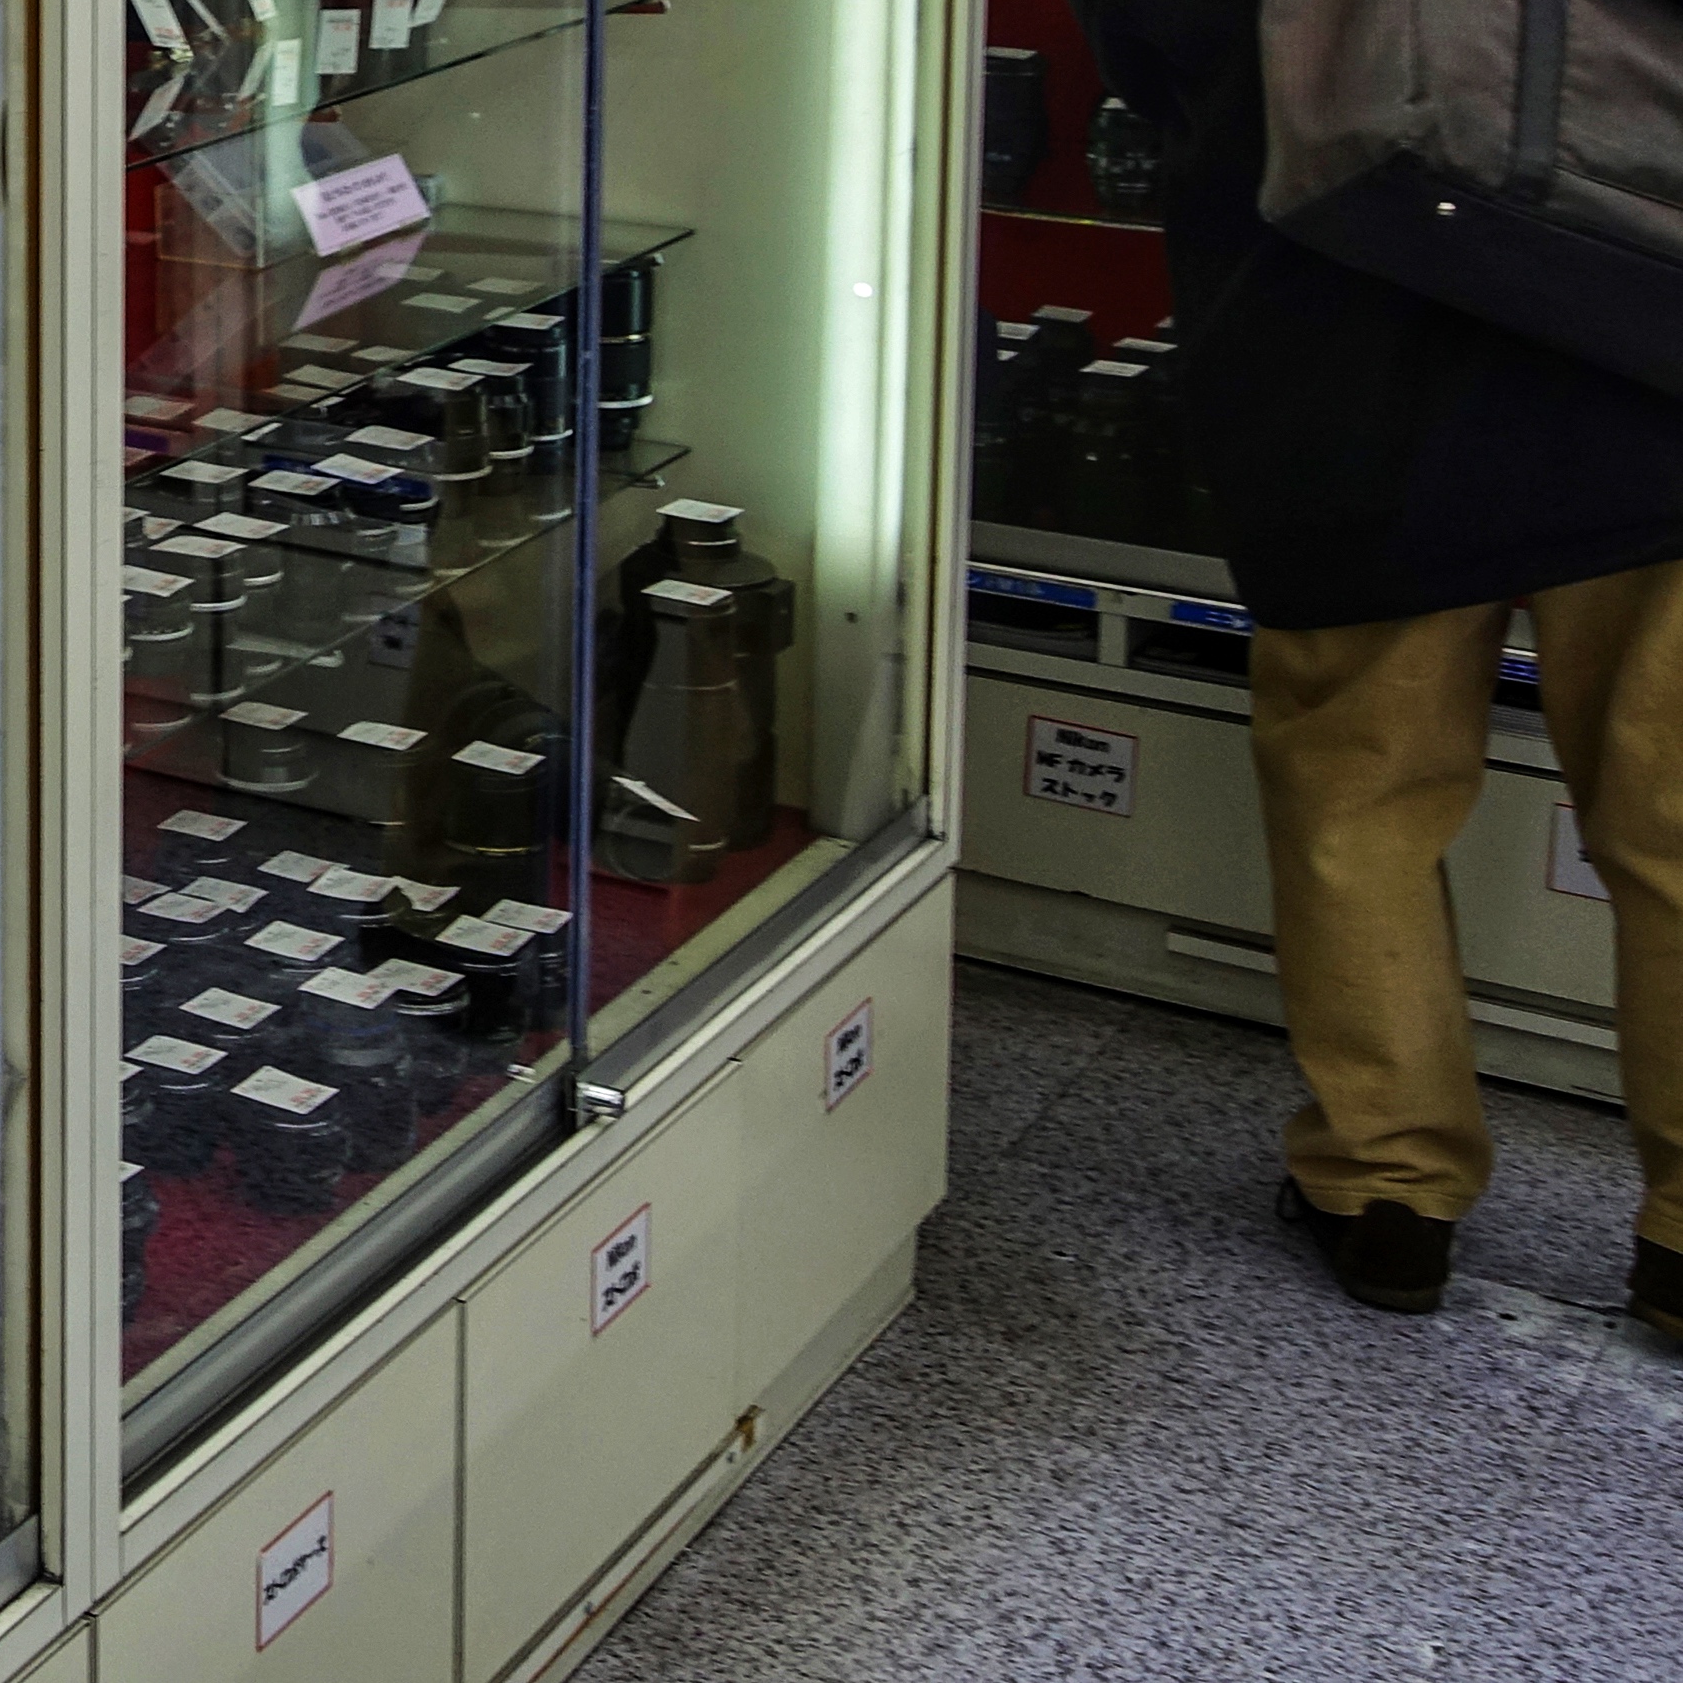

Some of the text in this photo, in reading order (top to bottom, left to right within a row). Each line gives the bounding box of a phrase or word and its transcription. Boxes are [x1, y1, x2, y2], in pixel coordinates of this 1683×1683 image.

[1066, 752, 1127, 784] カメラ
[1040, 776, 1119, 809] ストック
